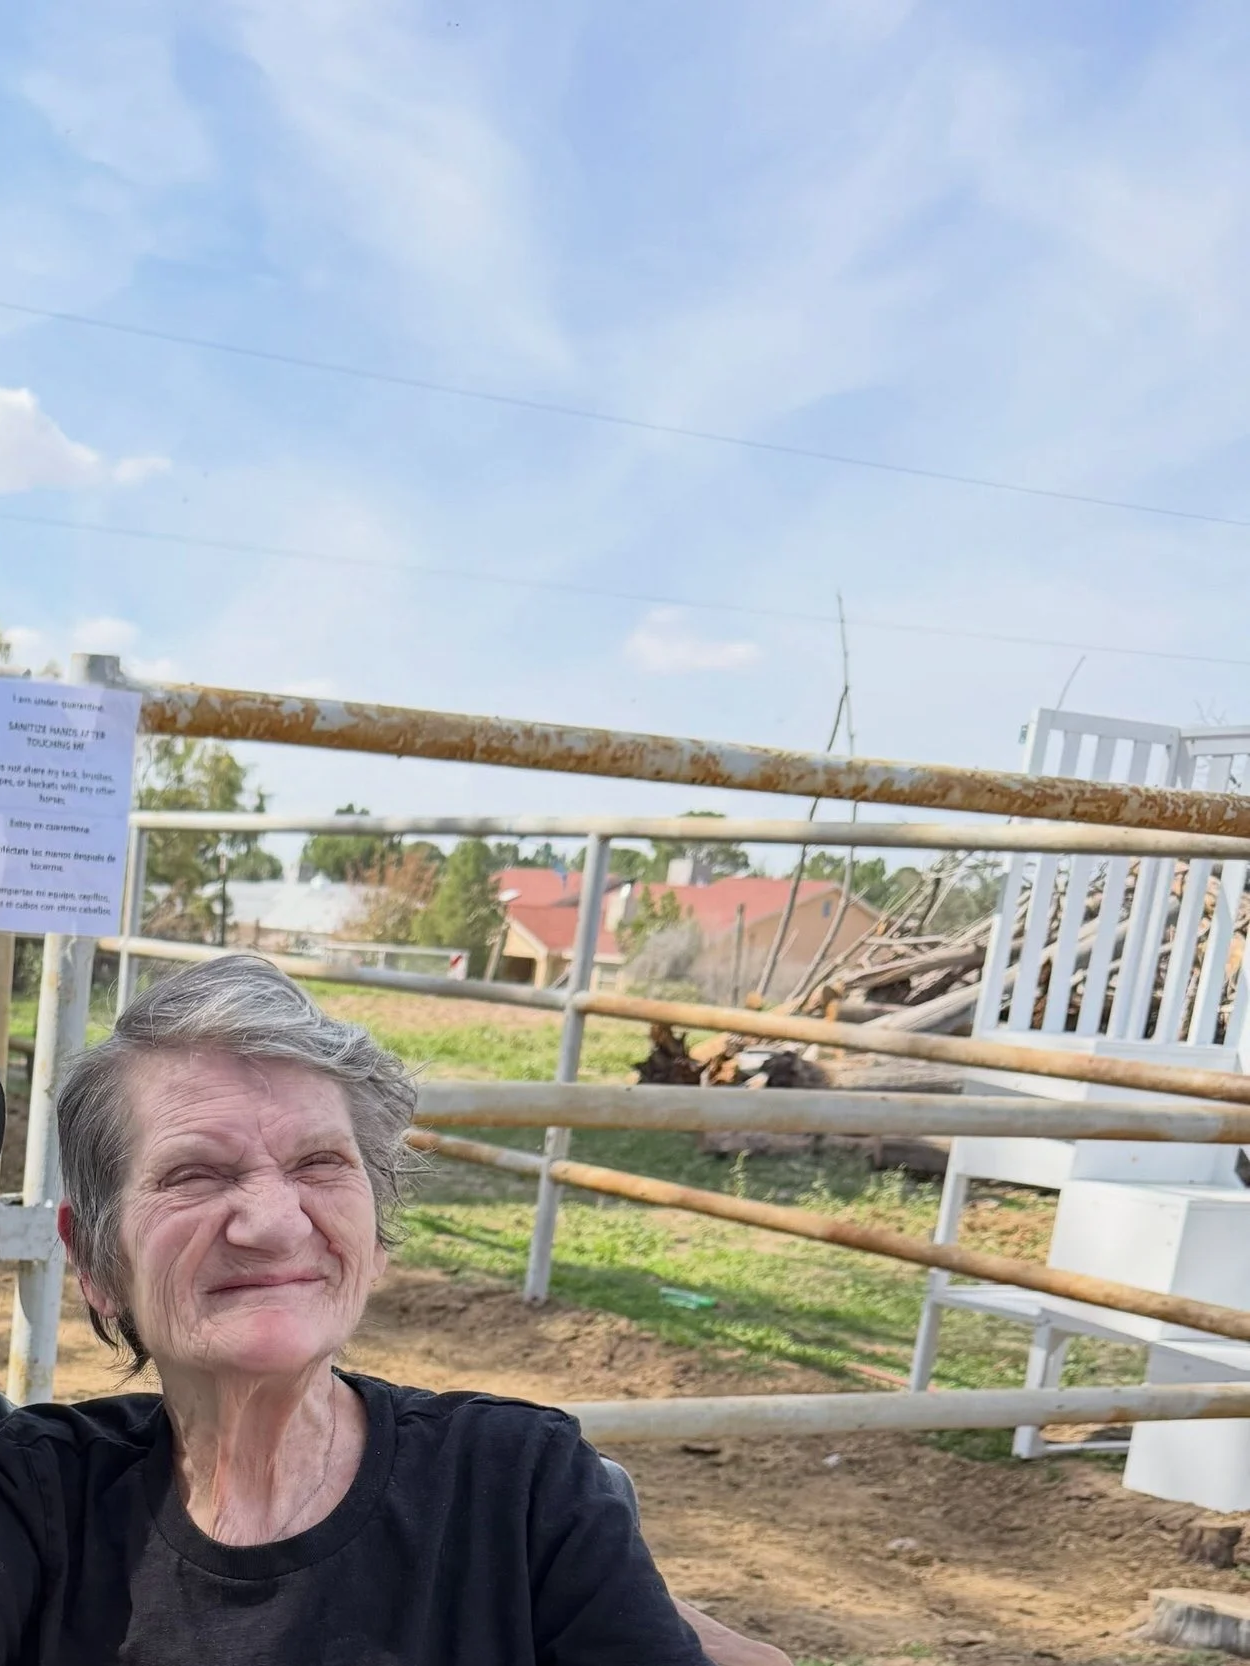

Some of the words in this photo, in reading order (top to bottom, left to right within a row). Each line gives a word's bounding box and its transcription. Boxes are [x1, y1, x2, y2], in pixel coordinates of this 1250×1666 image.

[8, 720, 47, 735] SANITIZE
[49, 726, 79, 738] HANDS
[26, 736, 71, 751] TOUCHING
